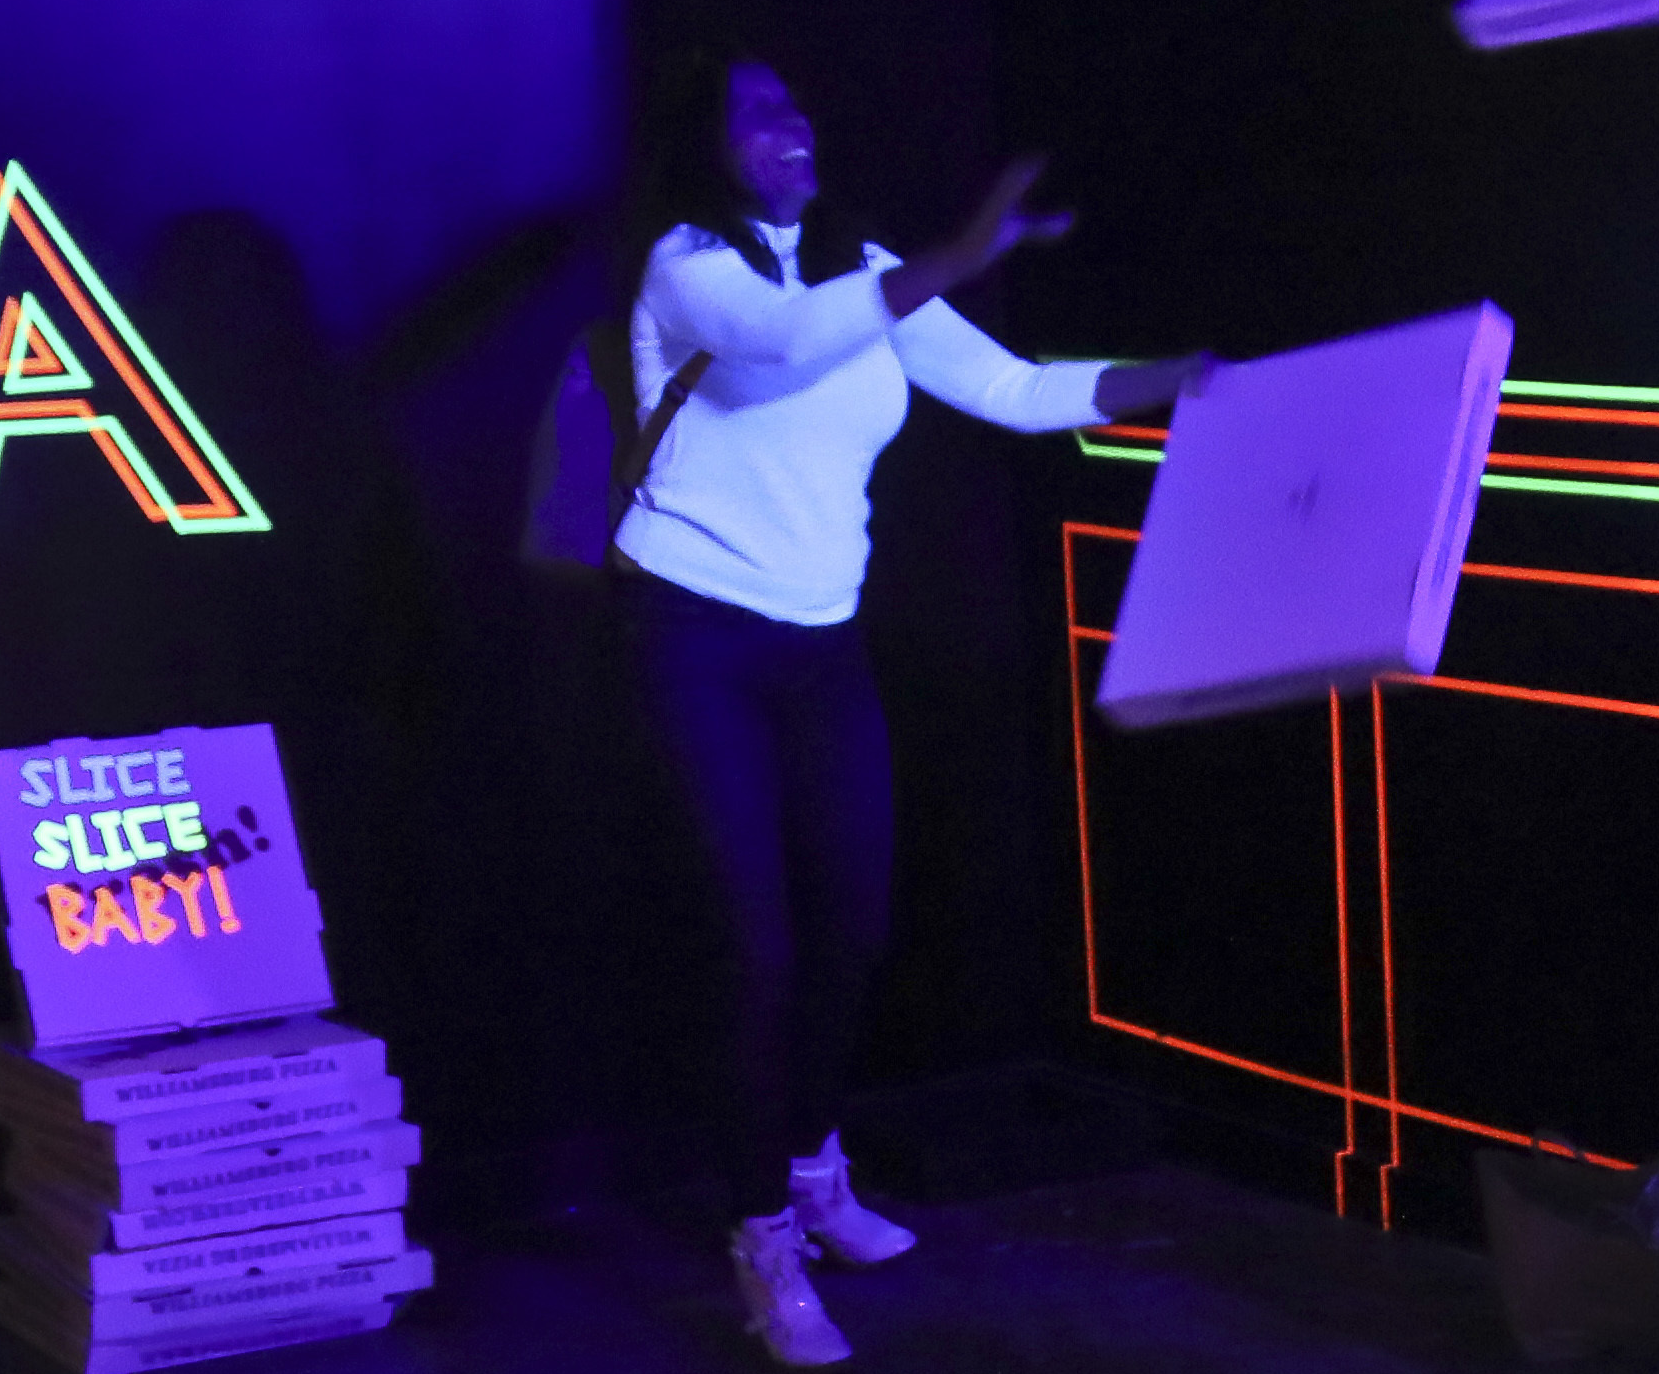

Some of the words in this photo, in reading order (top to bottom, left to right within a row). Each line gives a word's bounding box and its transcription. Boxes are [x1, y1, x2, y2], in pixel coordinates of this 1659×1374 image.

[19, 747, 191, 808] SLICE
[32, 800, 208, 874] SLICE
[45, 864, 242, 955] BABY!
